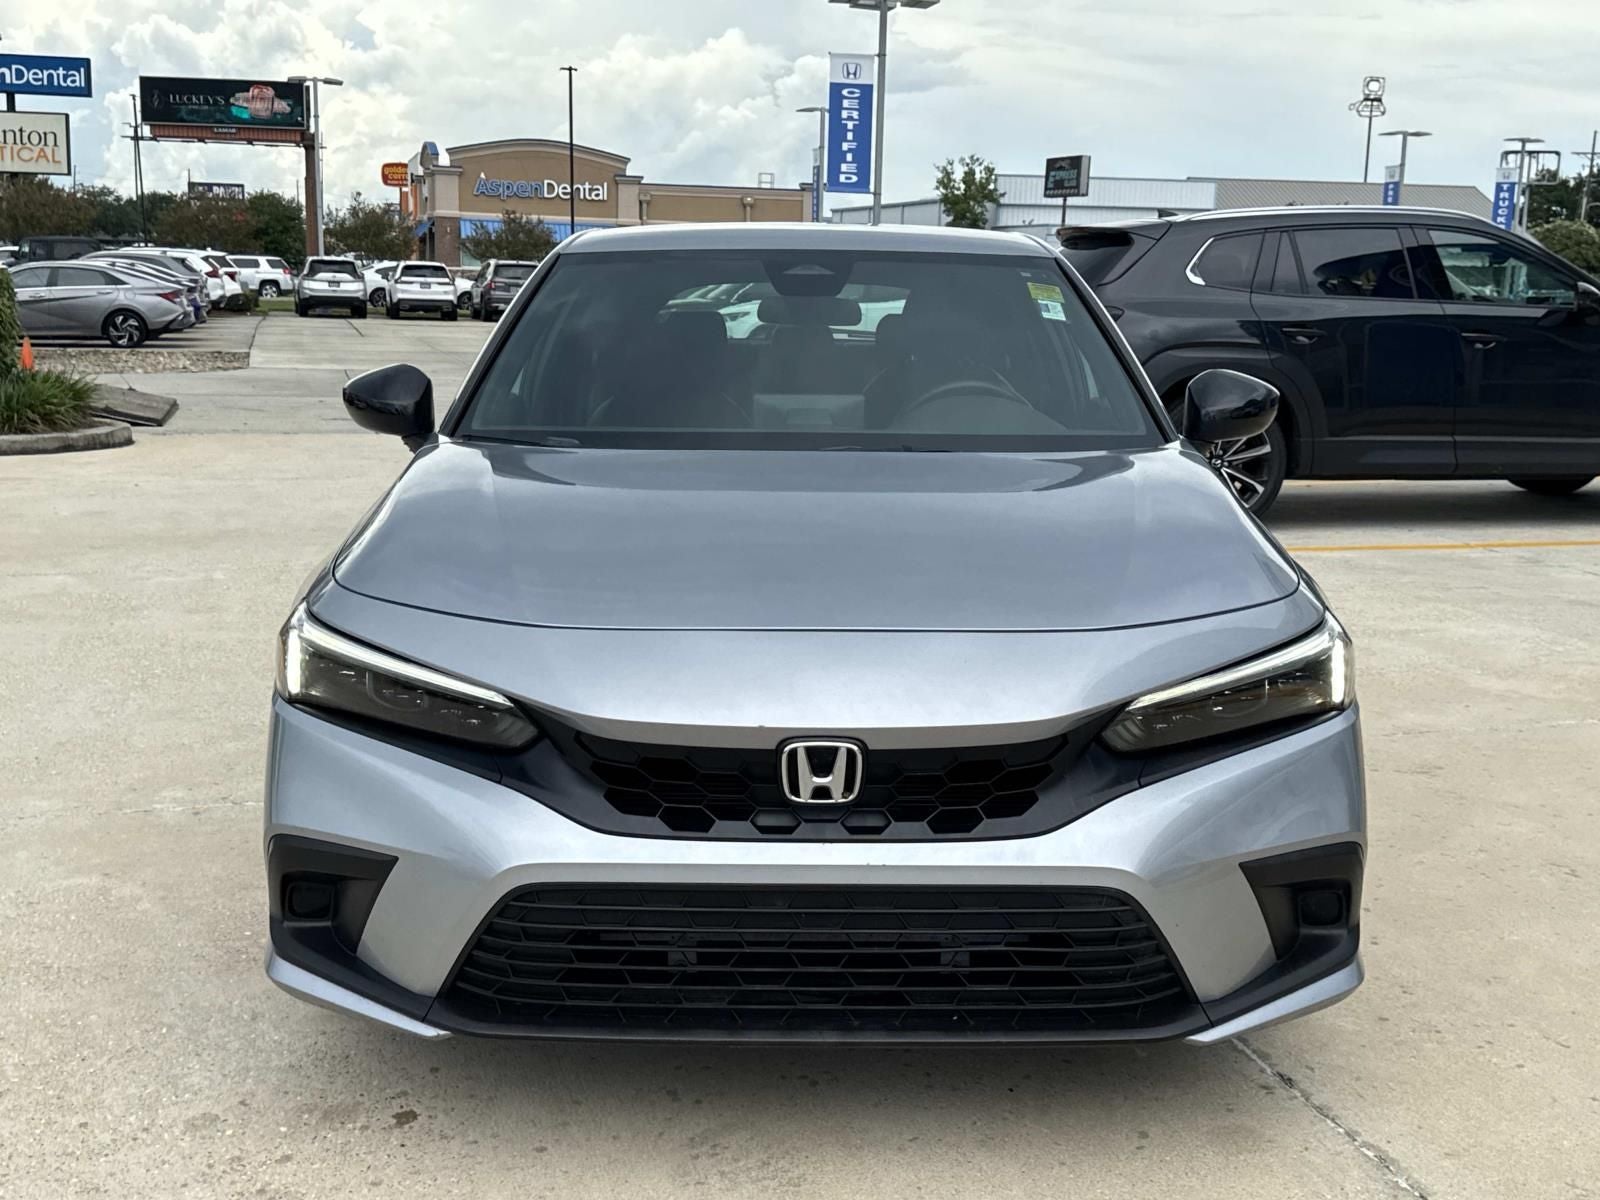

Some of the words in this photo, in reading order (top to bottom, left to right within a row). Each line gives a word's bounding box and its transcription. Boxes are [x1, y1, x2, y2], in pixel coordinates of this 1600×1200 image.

[0, 64, 85, 87] nDental
[169, 93, 225, 105] LUCKEY'S
[839, 88, 861, 183] CERTIFIED
[473, 172, 608, 200] AspenDental
